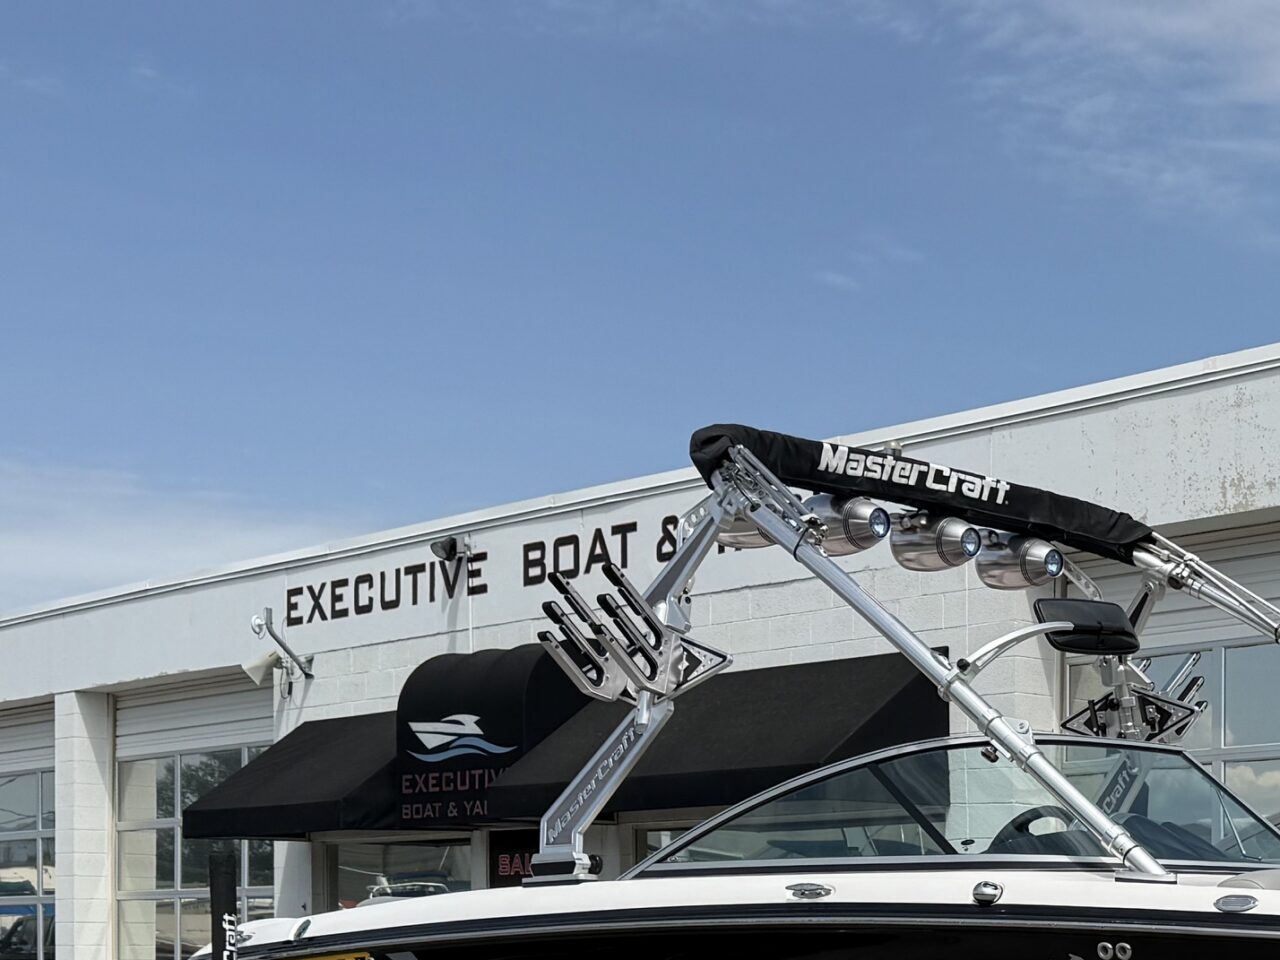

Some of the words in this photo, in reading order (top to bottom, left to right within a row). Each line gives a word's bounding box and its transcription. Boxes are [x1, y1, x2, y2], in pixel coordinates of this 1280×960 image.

[817, 442, 1010, 504] MasterCraft
[286, 552, 488, 627] EXECUTIVE
[523, 521, 637, 587] BOAT
[402, 802, 442, 819] BOAT
[447, 801, 458, 817] &
[547, 727, 635, 843] MasterCraft
